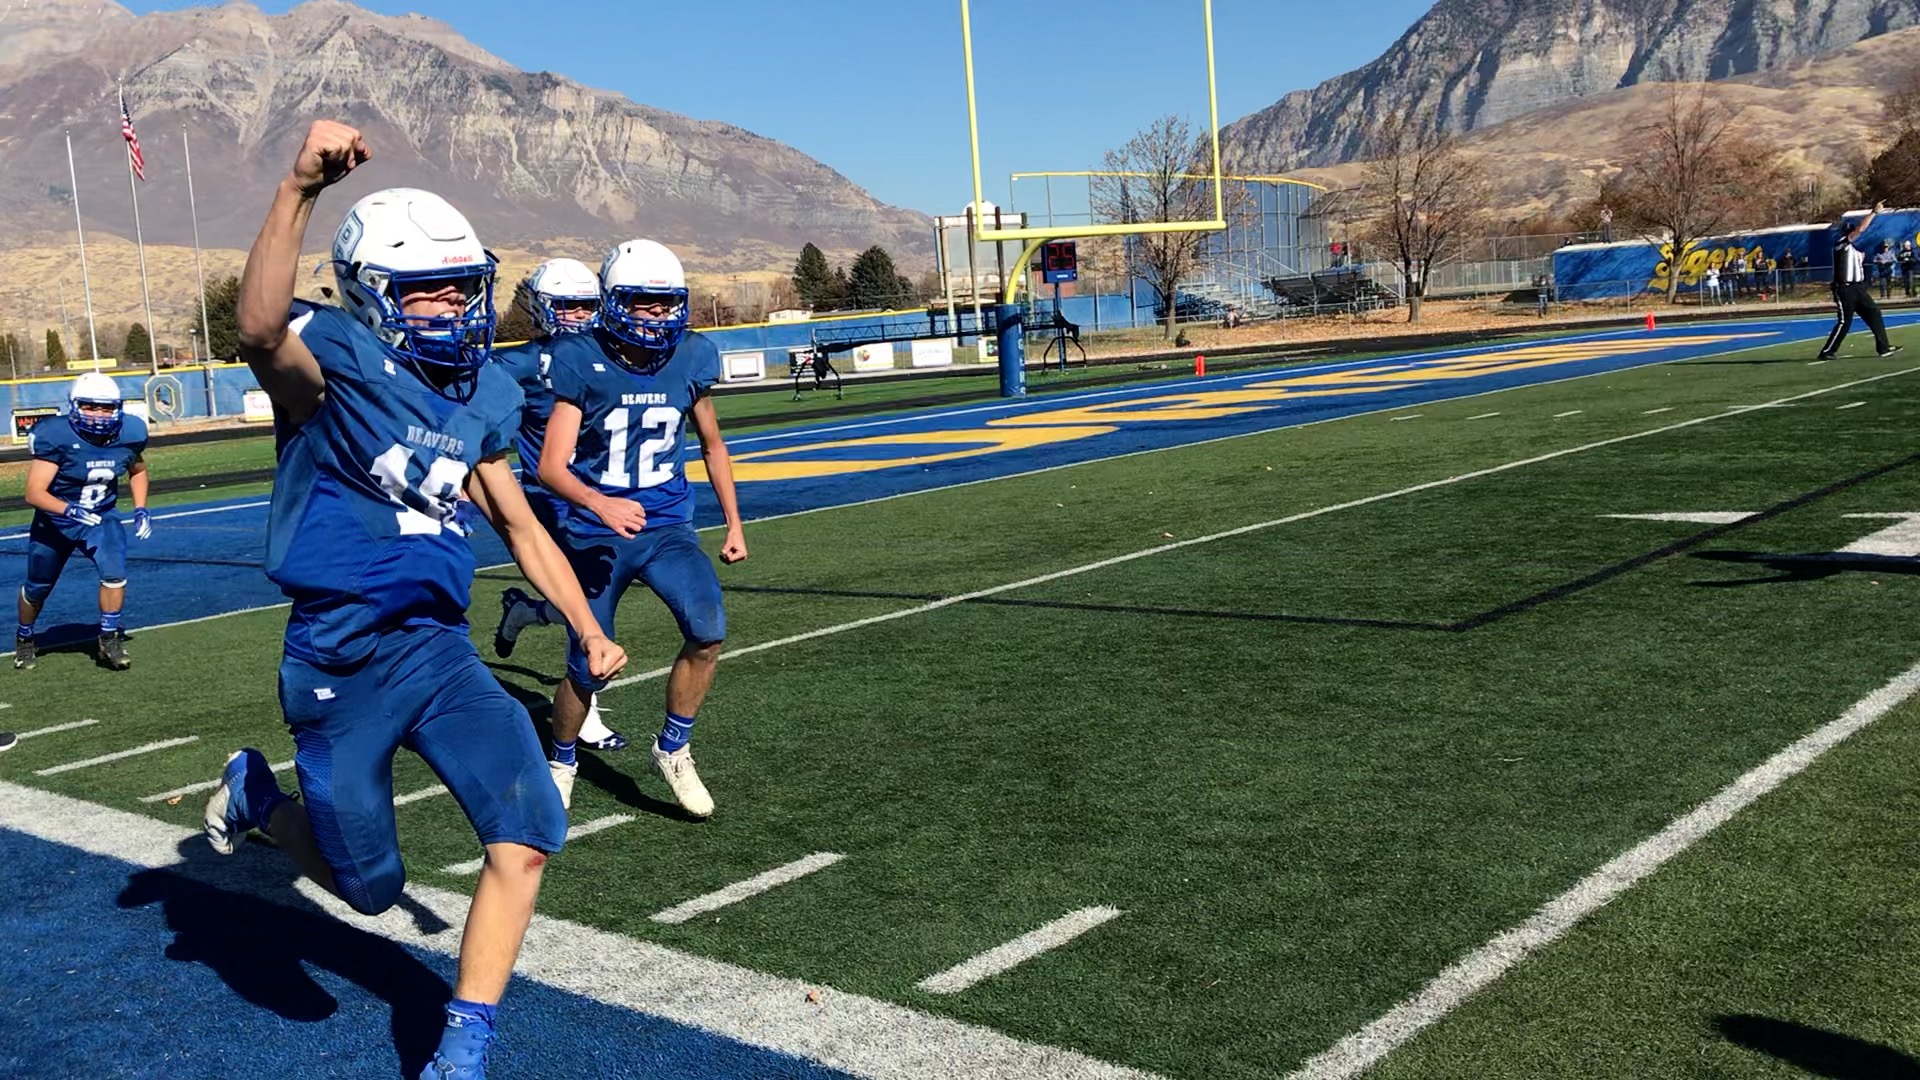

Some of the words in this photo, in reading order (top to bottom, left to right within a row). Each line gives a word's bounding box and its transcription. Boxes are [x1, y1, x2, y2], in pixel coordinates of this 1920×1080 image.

[621, 393, 667, 405] BEAVERS
[407, 424, 465, 455] BEAVERS
[600, 407, 681, 488] 12
